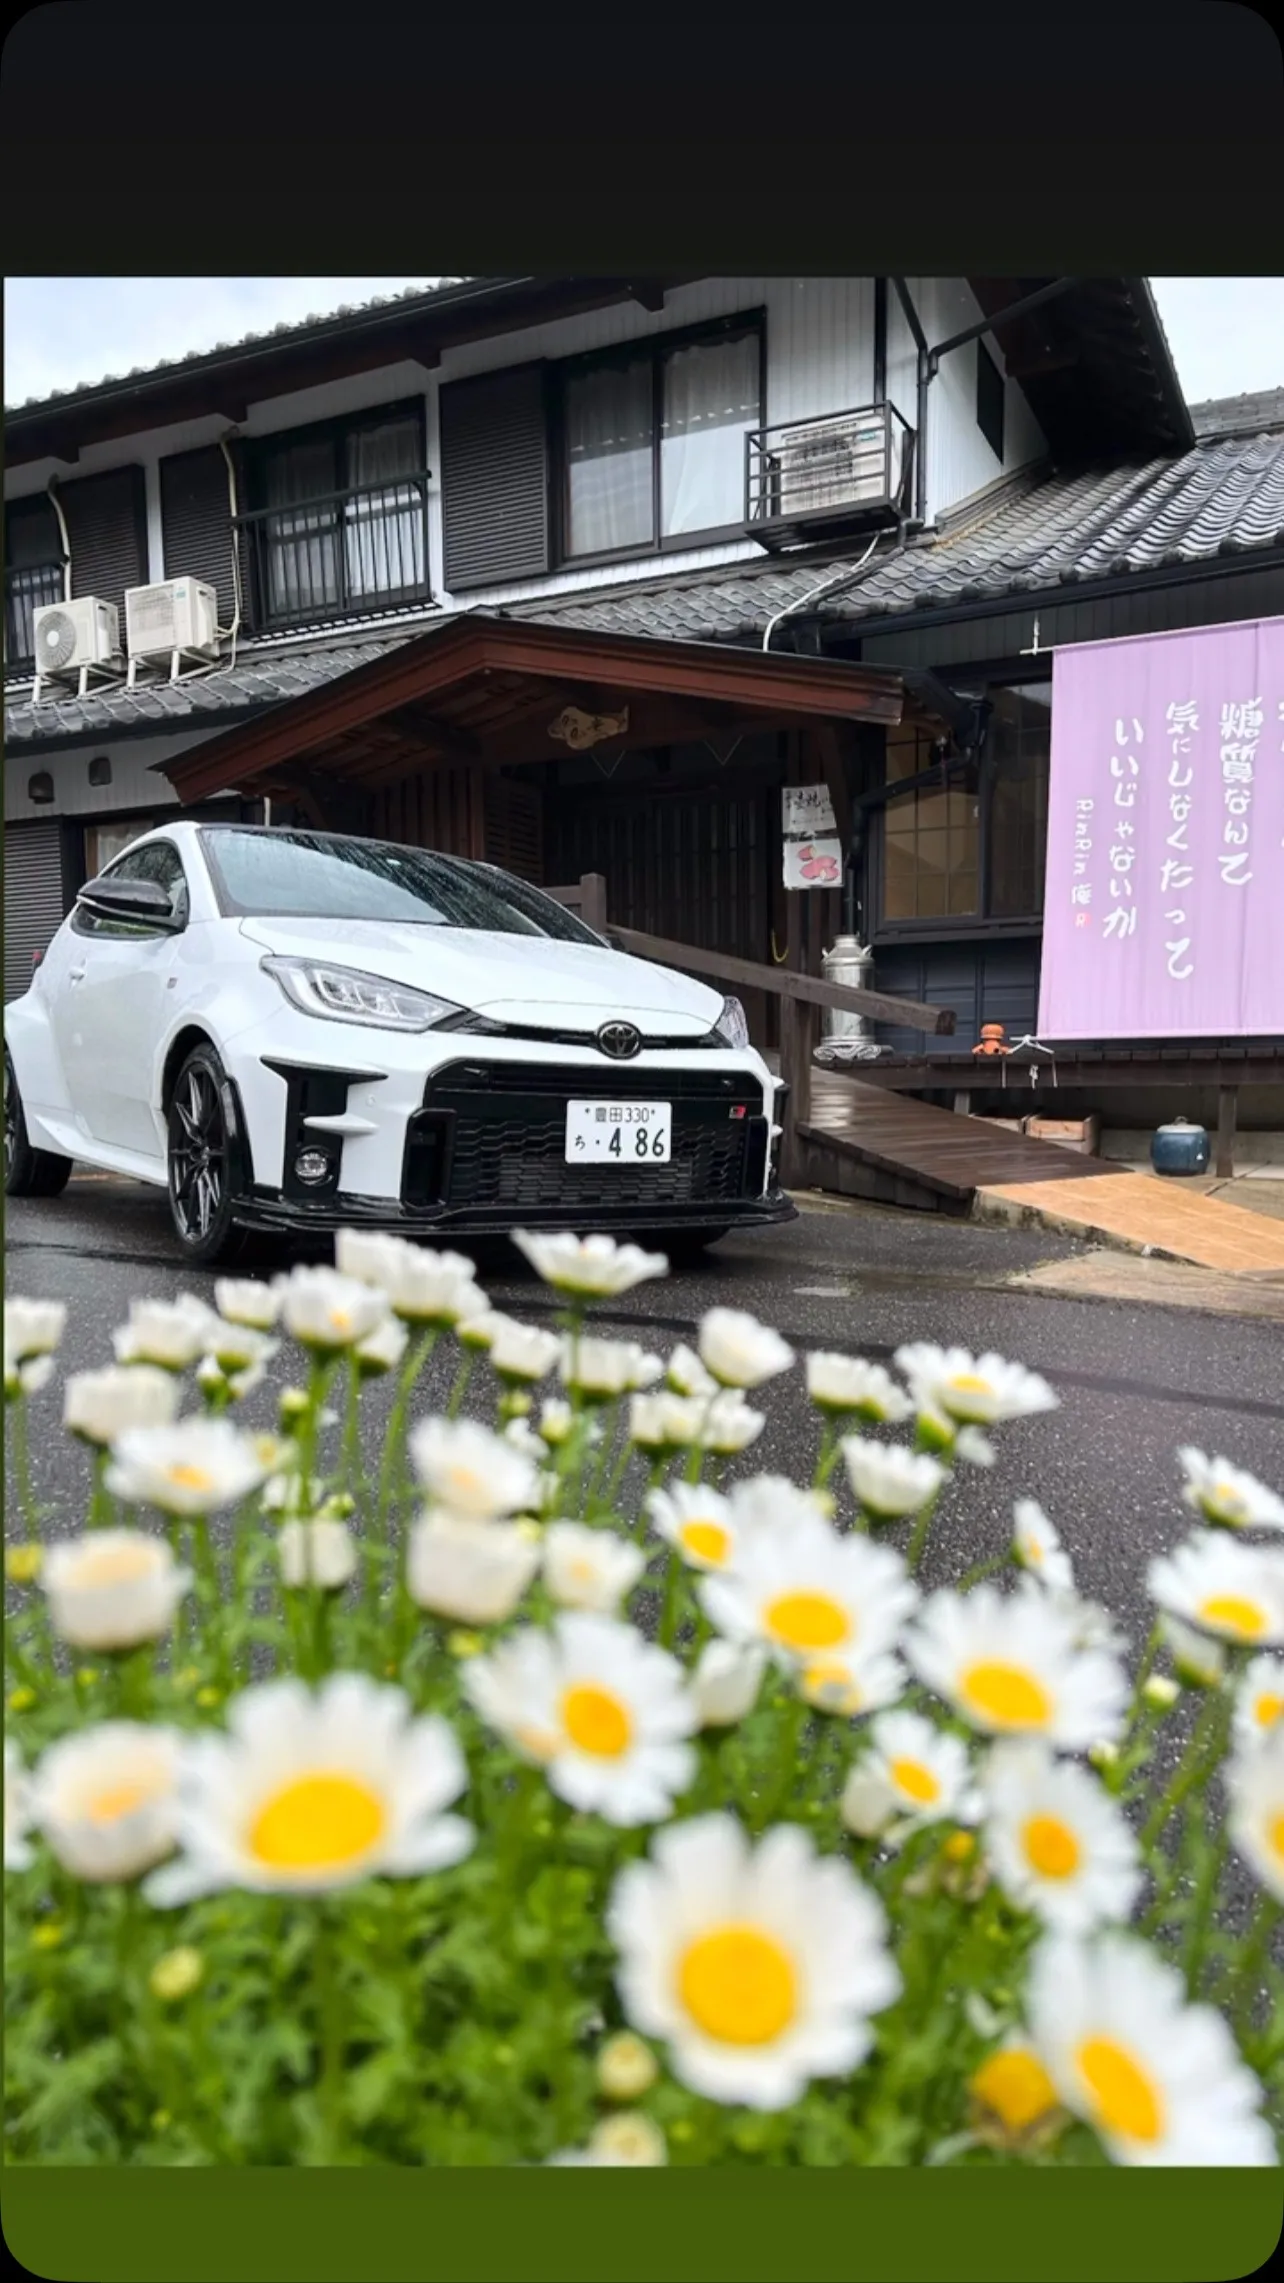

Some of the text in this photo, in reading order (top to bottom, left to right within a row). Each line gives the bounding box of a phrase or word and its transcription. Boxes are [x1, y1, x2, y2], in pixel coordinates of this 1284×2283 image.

[1102, 718, 1144, 939] いいじゃないか
[1160, 700, 1200, 979] 気にしなくたって
[1218, 697, 1264, 886] 糖質なんて
